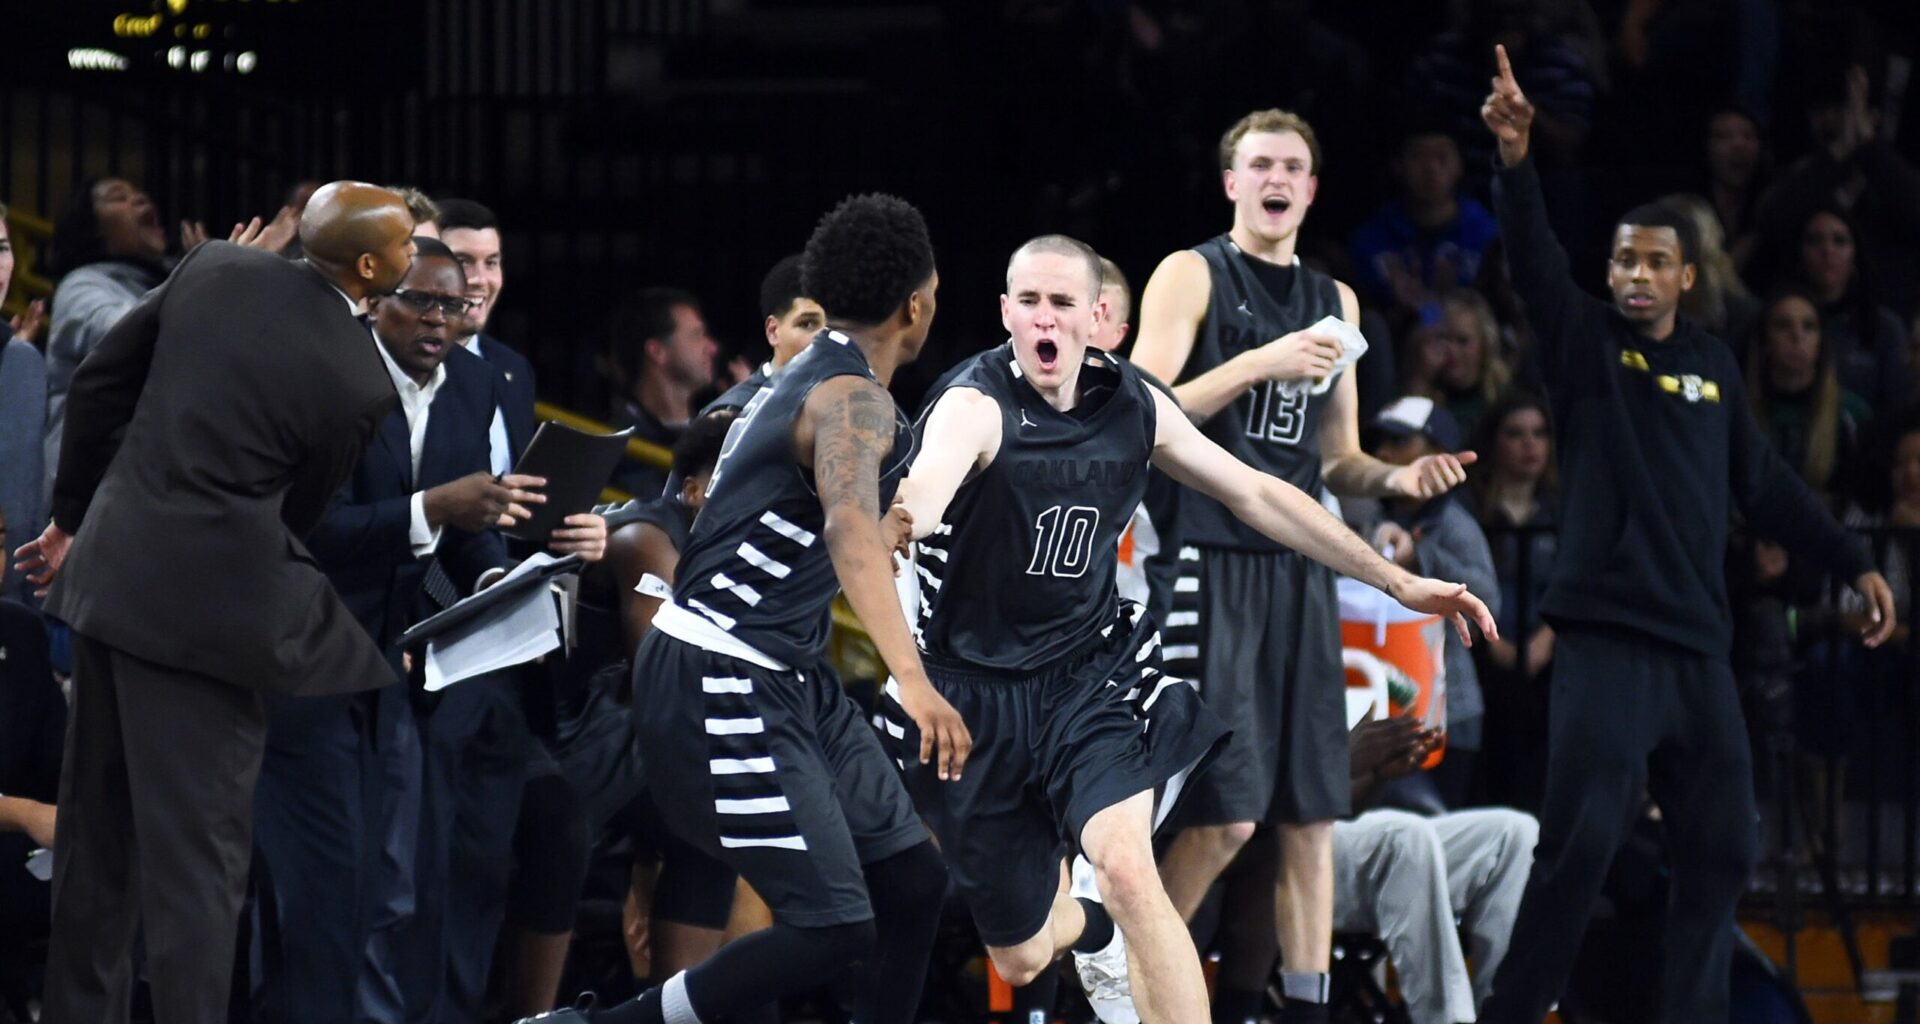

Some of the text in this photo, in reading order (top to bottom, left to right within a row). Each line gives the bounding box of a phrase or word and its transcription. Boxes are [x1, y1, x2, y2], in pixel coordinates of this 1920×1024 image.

[1246, 377, 1309, 446] 13
[1014, 459, 1137, 488] OAKLAND
[1025, 505, 1100, 578] 10
